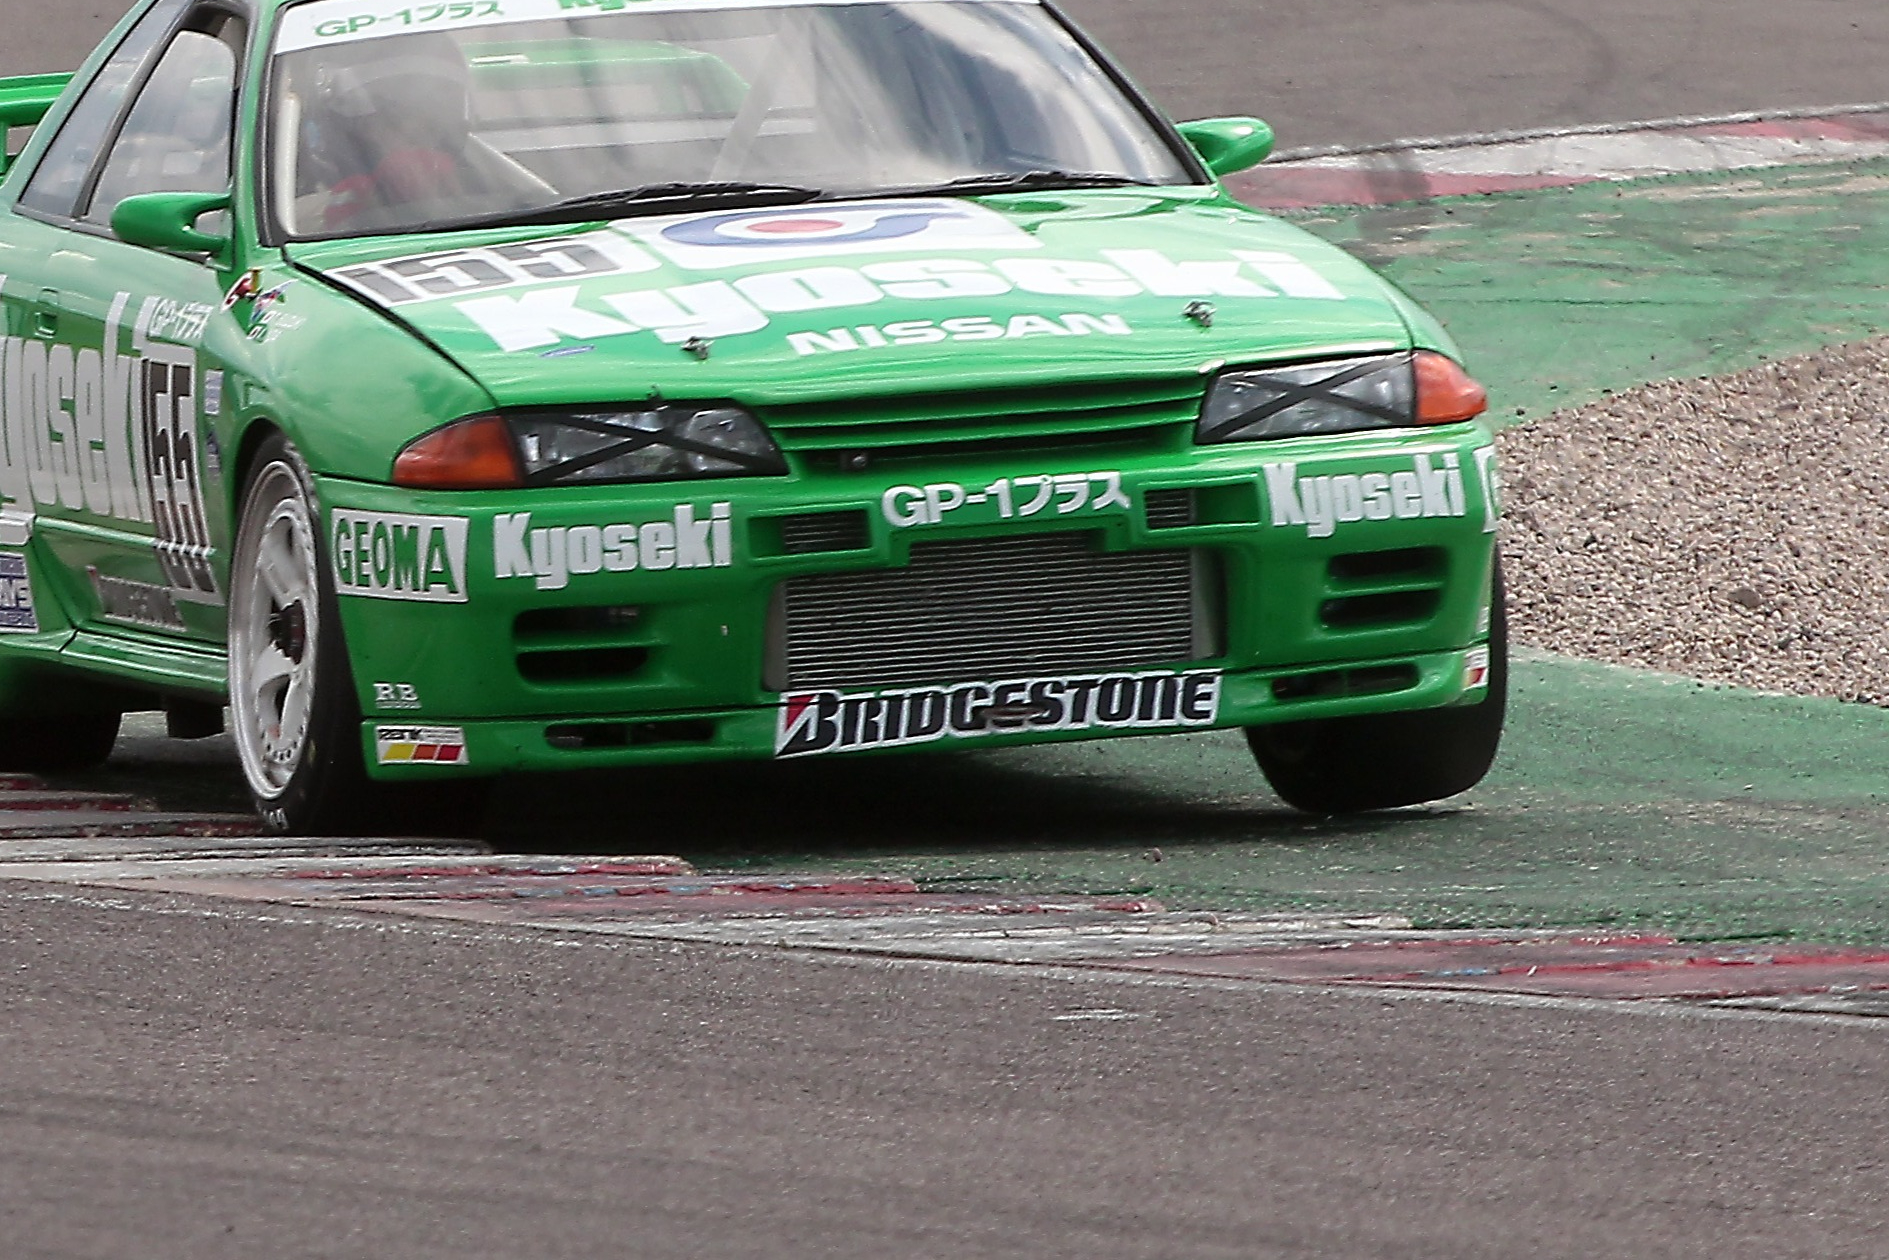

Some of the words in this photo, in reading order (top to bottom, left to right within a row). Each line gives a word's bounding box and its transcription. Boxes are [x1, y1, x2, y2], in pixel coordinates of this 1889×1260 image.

[335, 237, 623, 304] 155
[452, 248, 1348, 353] Kyoseki
[786, 311, 1134, 358] NISSAN
[881, 471, 1132, 528] GP-1プラス
[1263, 451, 1466, 538] Kyoseki
[334, 516, 459, 595] GEOMA
[493, 501, 732, 590] Kyoseki
[776, 669, 1220, 758] BRIDGESTONE
